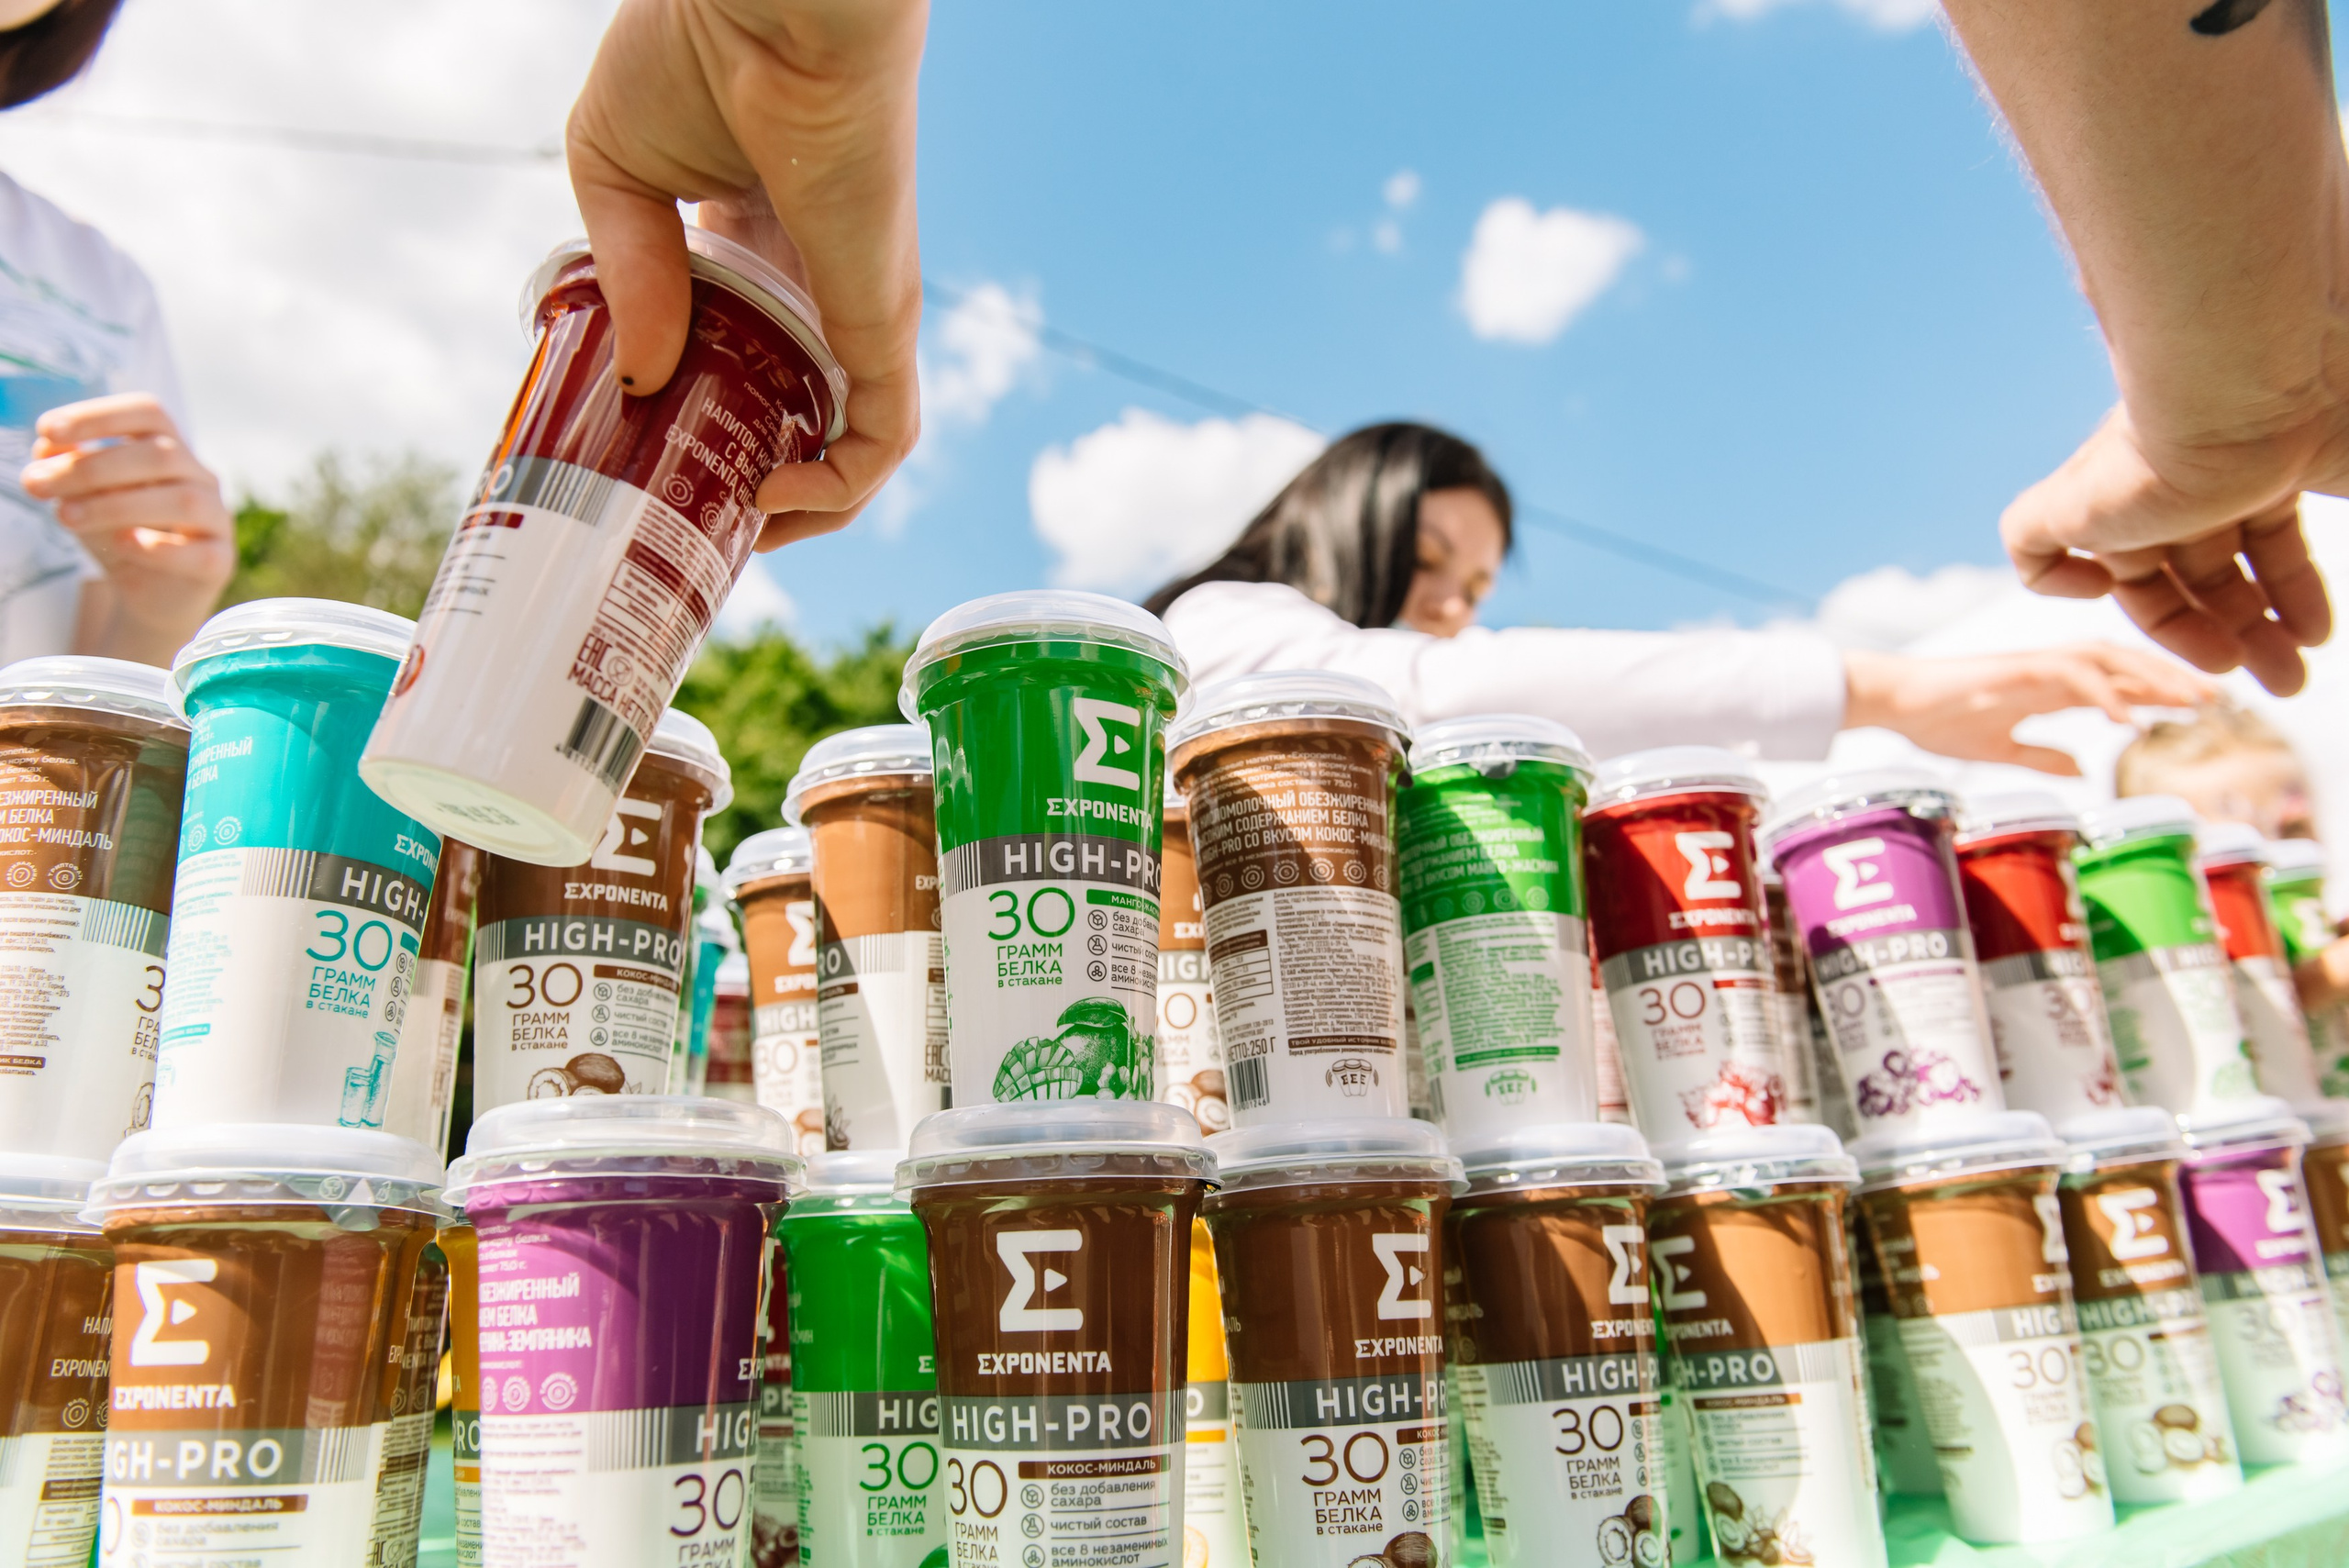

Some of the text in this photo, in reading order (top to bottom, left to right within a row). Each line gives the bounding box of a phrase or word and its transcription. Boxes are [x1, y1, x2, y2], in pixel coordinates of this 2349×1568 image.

[701, 397, 760, 456] НАПИТОК
[664, 424, 740, 491] EXPONENTA
[725, 442, 737, 459] С
[567, 662, 618, 706] МАССА
[9, 808, 54, 824] БЕЛКА
[1236, 808, 1369, 834] СОДЕРЖАНИЕМ БЕЛКА
[1244, 832, 1260, 849] СО
[1264, 826, 1312, 845] ВКУСОМ
[987, 887, 1075, 940] 30
[1113, 911, 1130, 924] без
[1112, 922, 1145, 937] сахара
[306, 909, 393, 971] 30
[525, 921, 682, 967] HIGH-PRO
[1111, 942, 1144, 955] чистый
[997, 943, 1063, 960] ГРАММ
[997, 960, 1063, 976] БЕЛКА
[1111, 964, 1136, 974] все 8
[312, 966, 376, 992] ГРАММ
[507, 962, 584, 1009] 30
[998, 975, 1063, 988] в стакане
[308, 984, 370, 1008] БЕЛКА
[617, 984, 634, 994] без
[306, 1000, 369, 1018] в стакане
[616, 995, 649, 1006] сахара
[1640, 981, 1706, 1026] 30
[513, 1012, 570, 1026] ГРАММ
[614, 1011, 647, 1022] чистый
[512, 1028, 569, 1041] БЕЛКА
[520, 1040, 569, 1051] стакане
[497, 1305, 539, 1327] БЕЛКА
[2083, 1335, 2144, 1376] 30
[51, 1359, 111, 1376] EXPONEN
[2009, 1346, 2068, 1389] 30
[952, 1402, 1152, 1443] HIGH-PRO
[1552, 1405, 1623, 1455] 30
[860, 1441, 938, 1491] 30
[1048, 1460, 1156, 1474] КОКОС-МИНДАЛЬ
[1300, 1431, 1389, 1486] 30
[1567, 1456, 1620, 1473] ГРАММ
[948, 1458, 1008, 1518] 30
[1051, 1480, 1155, 1496] без добавления
[1569, 1473, 1622, 1490] БЕЛКА
[1051, 1496, 1101, 1508] сахара
[1313, 1489, 1382, 1507] ГРАММ
[1581, 1488, 1623, 1499] стакане
[154, 1497, 284, 1512] КОКОС-МИНДАЛЬ
[670, 1469, 744, 1537] 30
[868, 1496, 926, 1509] ГРАММ
[867, 1512, 925, 1526] БЕЛКА
[1051, 1515, 1147, 1530] чистый состав
[1315, 1507, 1383, 1524] БЕЛКА
[876, 1526, 925, 1536] стакане
[955, 1521, 998, 1541] ГРАММ
[1317, 1522, 1384, 1535] в стакане
[678, 1538, 735, 1562] ГРАММ
[956, 1541, 998, 1562] БЕЛКА
[1052, 1538, 1168, 1555] все 8 незаменимых
[1052, 1553, 1140, 1568] аминокислот
